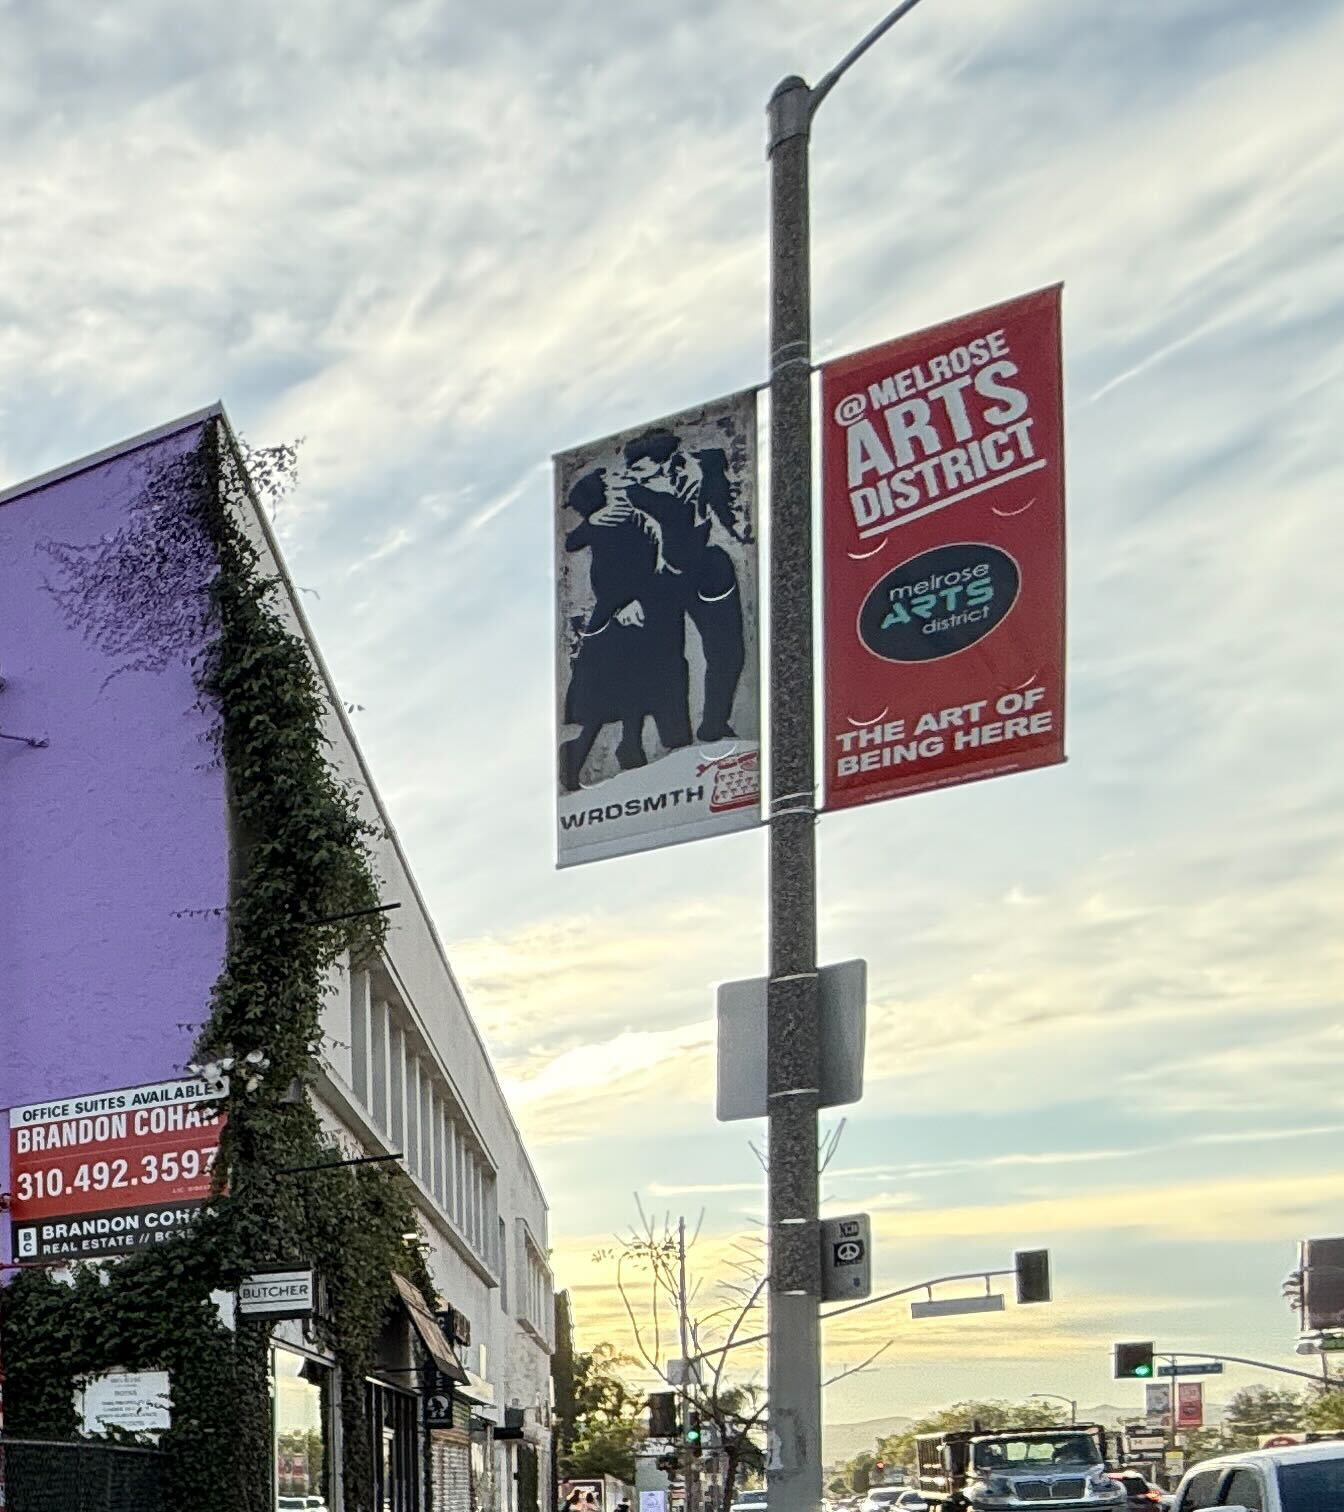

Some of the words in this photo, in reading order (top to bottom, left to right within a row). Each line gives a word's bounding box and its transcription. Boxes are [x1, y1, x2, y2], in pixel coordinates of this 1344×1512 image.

[847, 360, 1029, 489] ARTS
[849, 418, 1034, 527] DISTRICT
[890, 563, 989, 601] melrose
[880, 576, 994, 630] ARTS
[921, 605, 989, 635] district
[836, 719, 905, 752] THE
[914, 700, 988, 736] ART
[995, 687, 1046, 715] OF
[837, 736, 944, 777] BEING
[954, 711, 1052, 751] HERE
[560, 785, 704, 830] WRDSMTH
[22, 1104, 70, 1122] OFFICE
[74, 1095, 125, 1114] SUITES
[131, 1083, 213, 1107] AVAILABLE
[16, 1113, 127, 1154] BRANDON
[42, 1215, 140, 1240] BRANDON
[42, 1242, 78, 1255] REAL
[81, 1234, 134, 1251] ESTATE
[242, 1284, 309, 1299] BUTCHER
